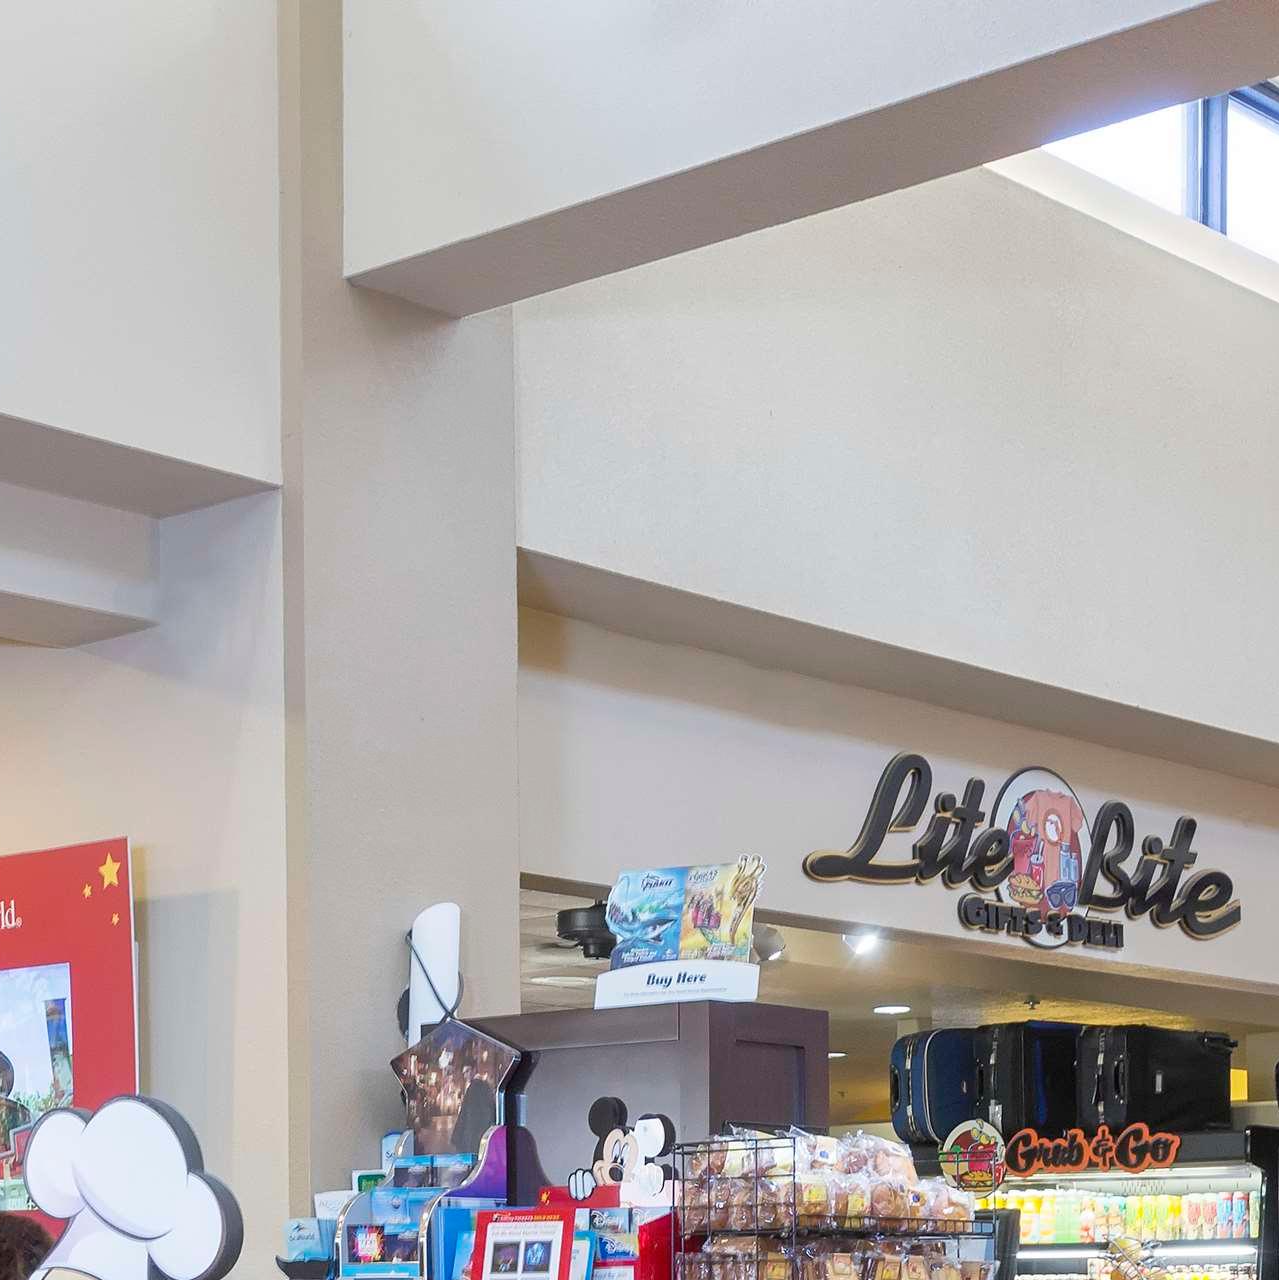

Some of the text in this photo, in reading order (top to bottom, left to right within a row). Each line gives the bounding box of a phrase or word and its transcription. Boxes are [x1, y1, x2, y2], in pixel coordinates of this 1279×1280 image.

[803, 751, 1242, 941] Lite Bite
[646, 971, 707, 988] Buy Here
[1005, 1132, 1085, 1173] Grub
[1116, 1126, 1171, 1168] Go
